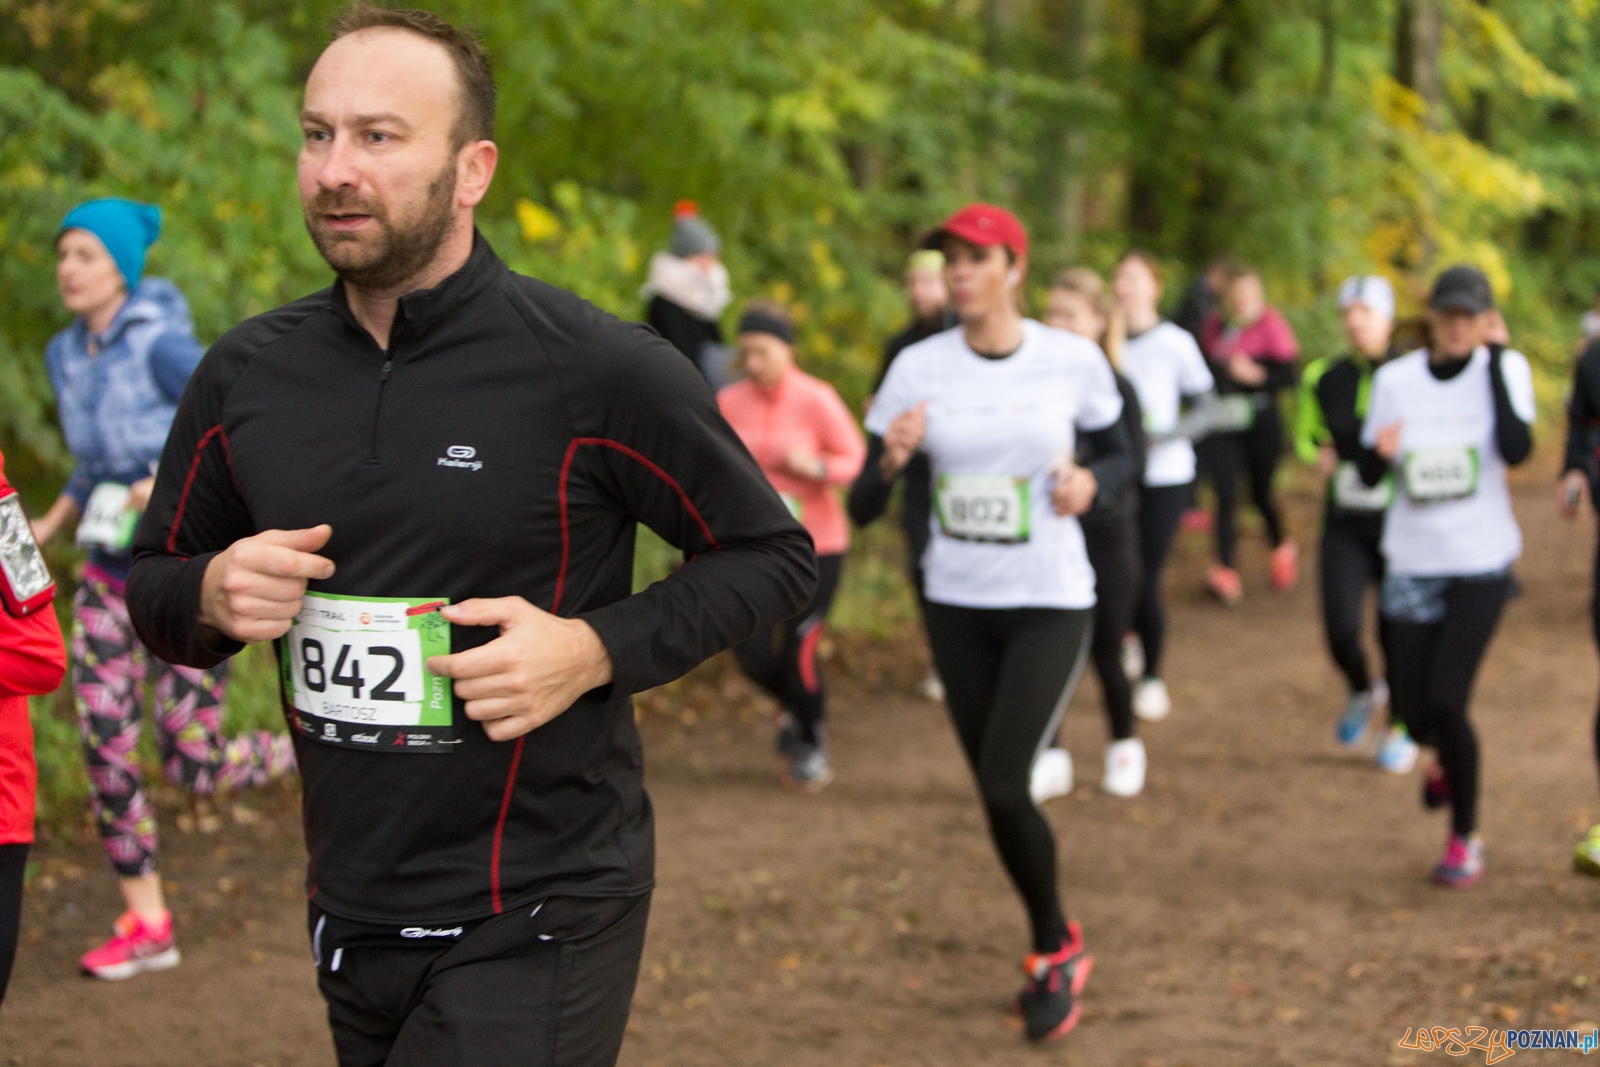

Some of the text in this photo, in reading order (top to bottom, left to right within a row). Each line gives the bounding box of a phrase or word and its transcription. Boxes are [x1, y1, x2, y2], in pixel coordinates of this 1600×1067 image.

[949, 494, 1010, 524] 802
[302, 637, 406, 702] 842
[430, 677, 444, 709] Pozn
[321, 701, 377, 721] BARTOSZ
